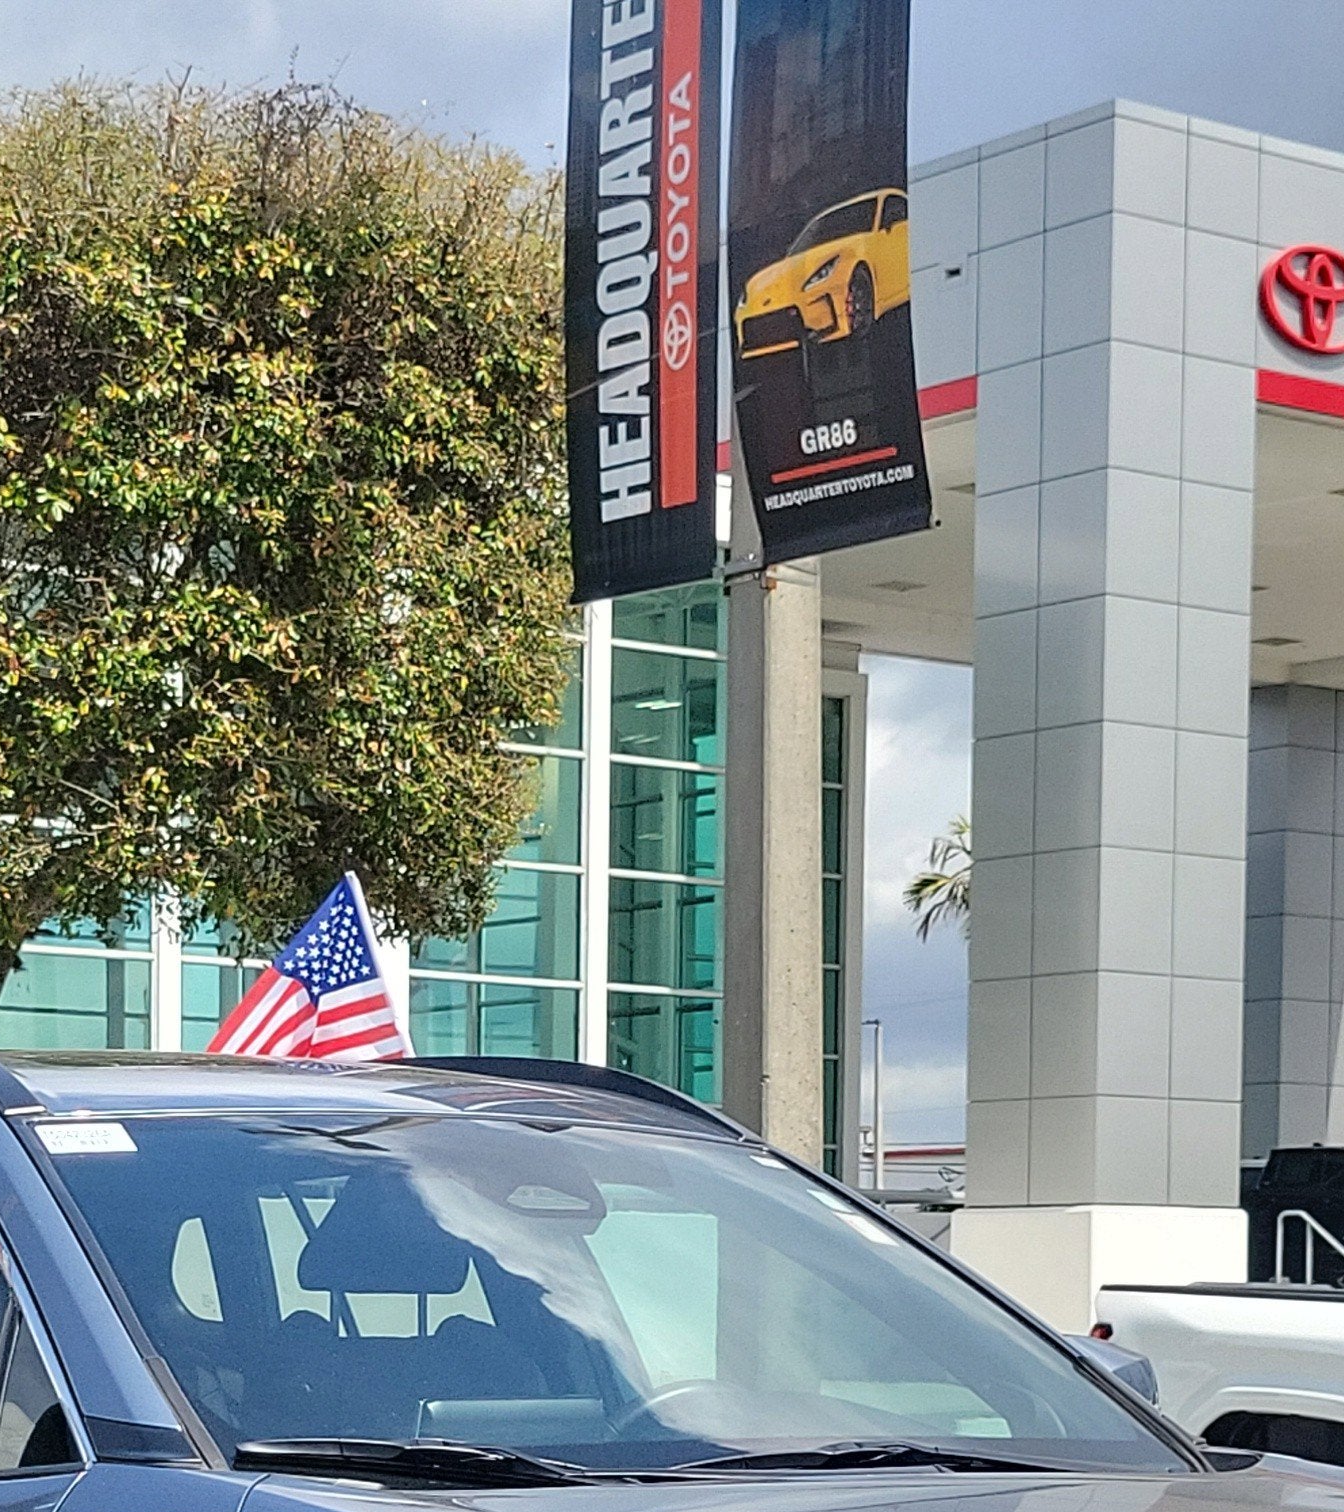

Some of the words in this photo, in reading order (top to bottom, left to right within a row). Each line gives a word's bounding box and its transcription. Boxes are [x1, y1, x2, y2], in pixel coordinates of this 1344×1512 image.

[665, 71, 693, 299] TOYOTA
[596, 0, 655, 524] HEADQUARTE
[764, 464, 915, 512] HEADQUARTERTOYOTA.COM
[800, 418, 857, 455] GR86
